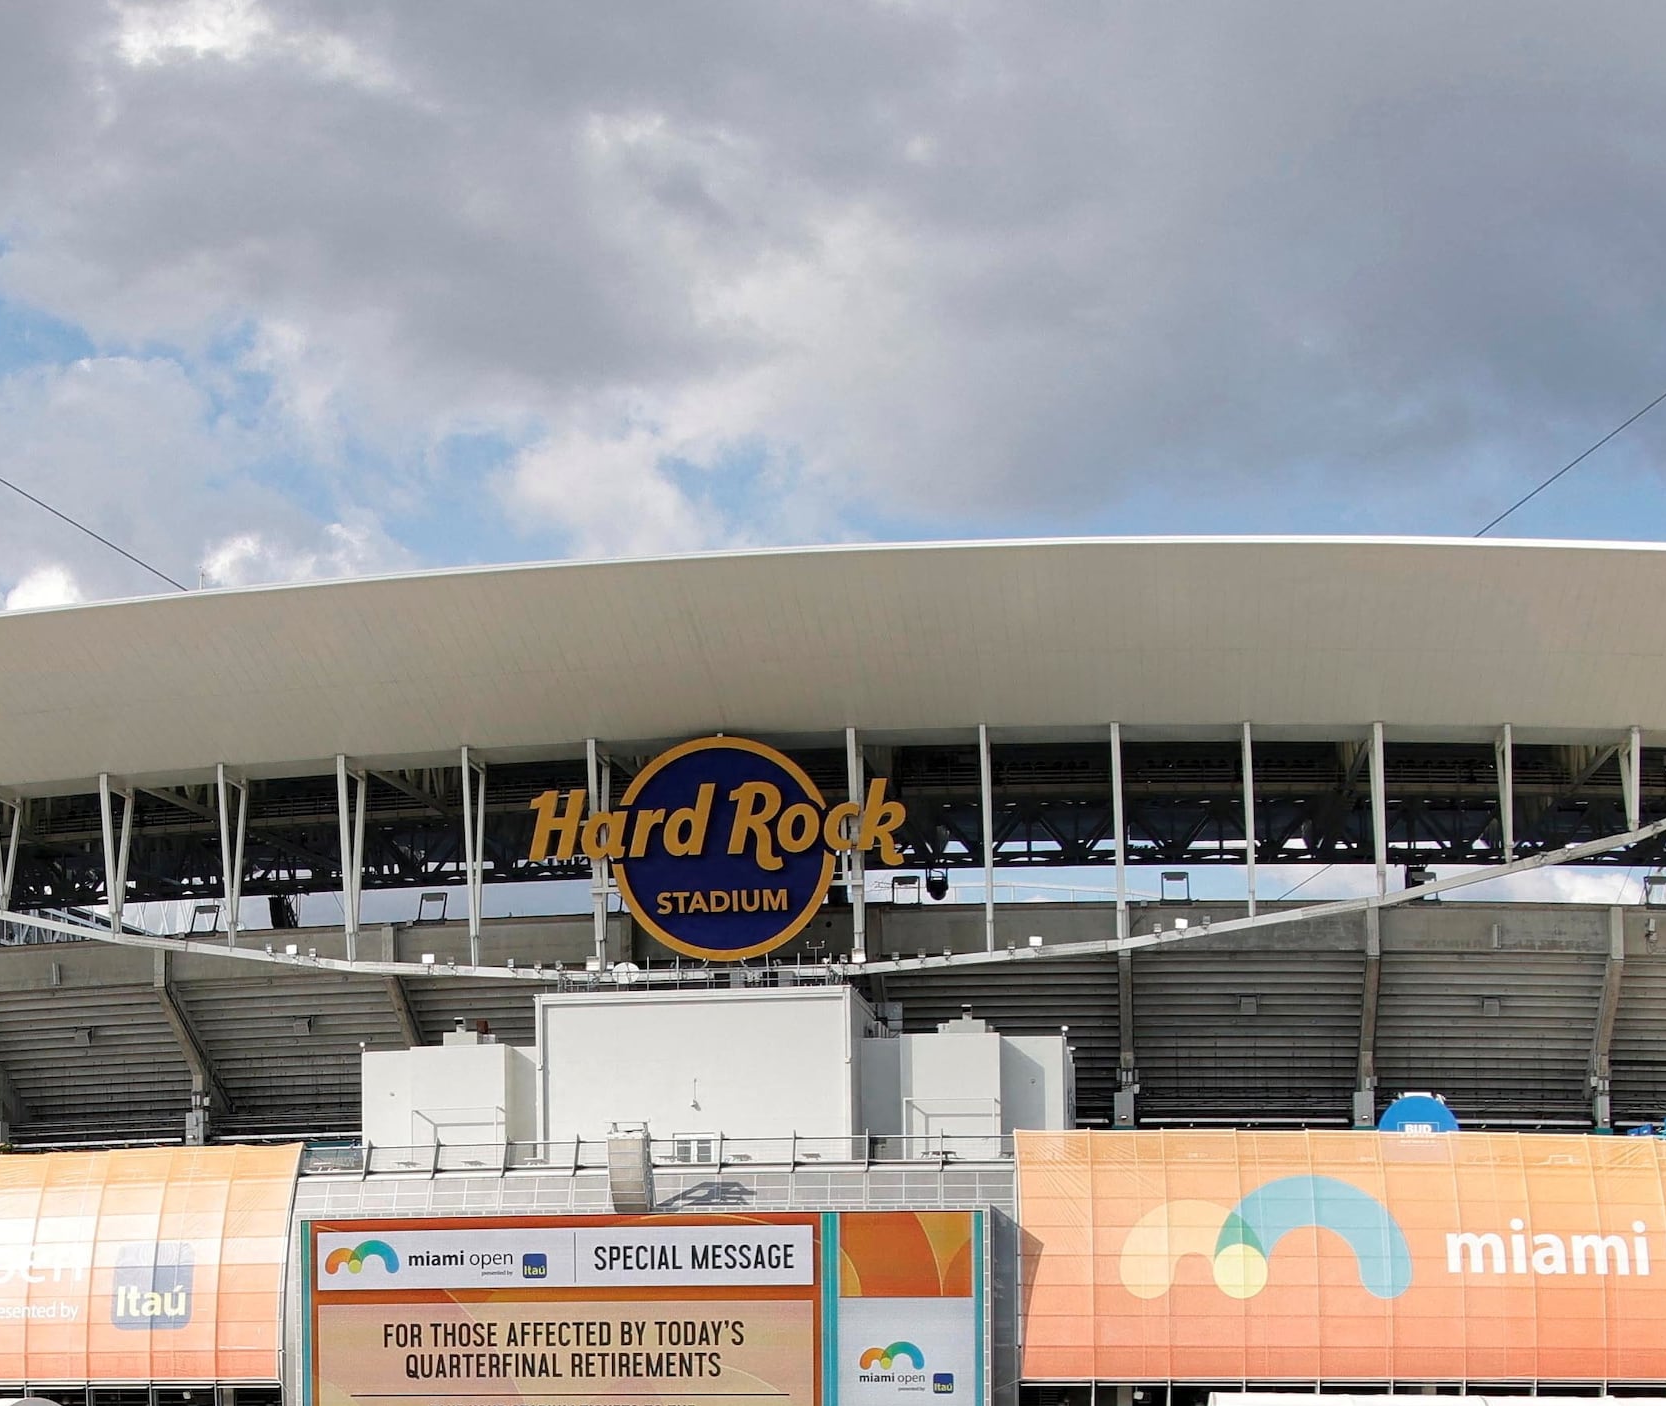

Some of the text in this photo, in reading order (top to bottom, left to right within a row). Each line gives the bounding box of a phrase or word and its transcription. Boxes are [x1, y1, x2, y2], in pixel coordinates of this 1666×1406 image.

[528, 777, 907, 872] Hard Rock
[655, 888, 789, 915] STADIUM
[408, 1250, 513, 1270] miami open
[594, 1244, 794, 1271] SPECIAL MESSAGE
[1445, 1218, 1650, 1277] miami
[523, 1264, 547, 1276] Itaú
[59, 1302, 79, 1322] by
[116, 1284, 186, 1318] Itaú
[383, 1319, 744, 1348] FOR THOSE AFFECTED BY TODAY'S
[405, 1352, 721, 1380] QUARTERFINAL RETIREMENTS
[859, 1372, 926, 1385] miami open
[933, 1382, 953, 1392] Itaú
